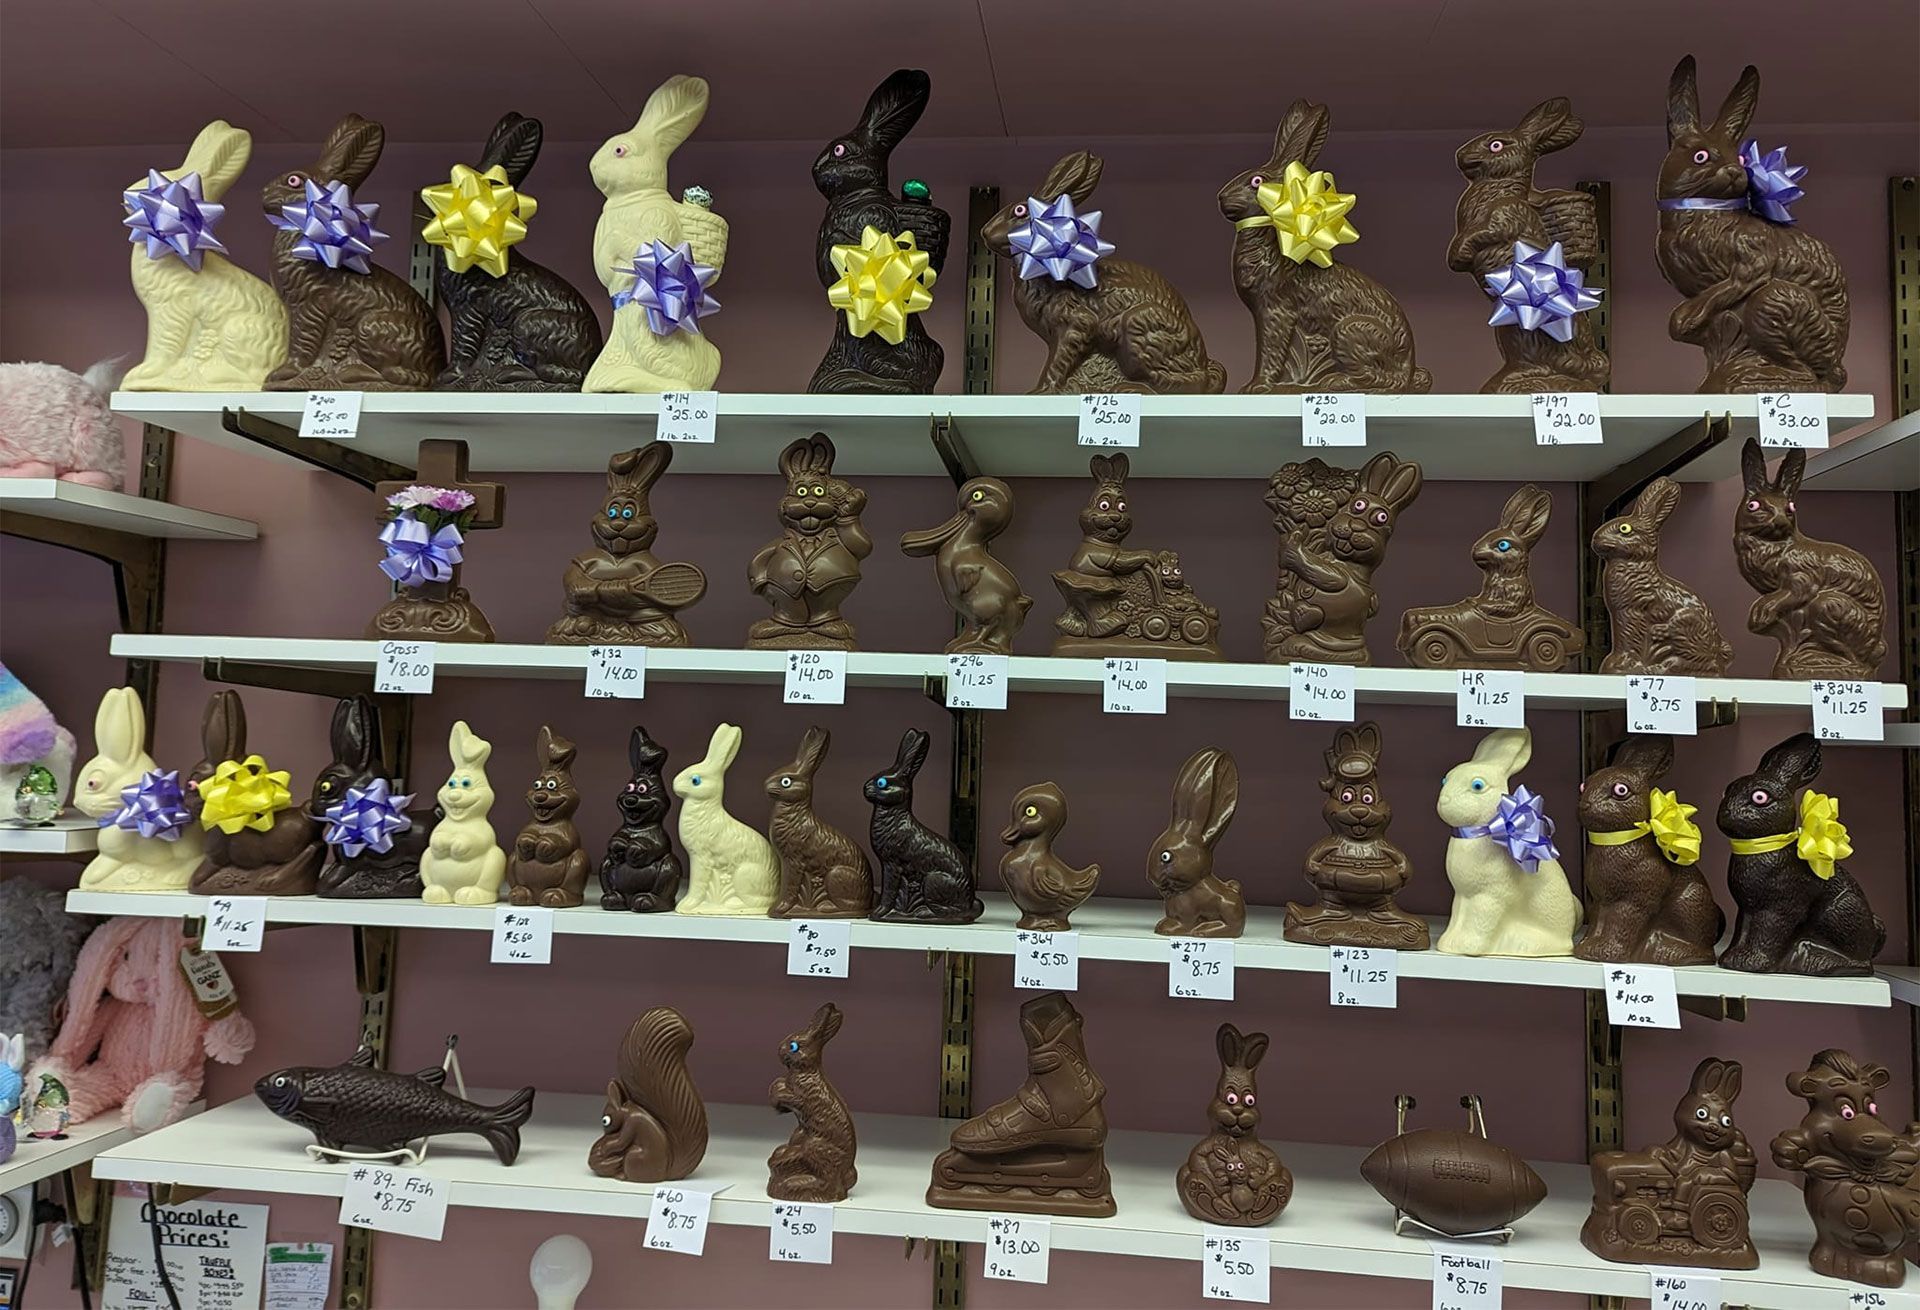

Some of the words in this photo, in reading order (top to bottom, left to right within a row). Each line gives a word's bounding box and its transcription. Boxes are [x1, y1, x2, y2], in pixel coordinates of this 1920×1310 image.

[663, 393, 690, 405] #114
[1083, 395, 1118, 406] #126
[1305, 395, 1339, 406] #230
[1532, 395, 1568, 407] #197
[666, 405, 709, 421] $25.00
[1091, 406, 1131, 424] $25.00
[1314, 407, 1356, 425] $22.00
[1546, 409, 1595, 428] $22.00
[1768, 408, 1820, 428] $33.00
[383, 641, 420, 655] Cross
[591, 648, 622, 659] #132
[388, 655, 430, 677] $18.00
[790, 653, 821, 664] #120
[950, 655, 984, 667] #296
[1106, 660, 1139, 671] #121
[600, 660, 638, 680] $14.00
[791, 662, 834, 682] $14.00
[955, 668, 996, 686] $11.25
[1293, 665, 1328, 678] #140
[1111, 674, 1148, 691] $14.00
[1629, 678, 1665, 691] #77
[1813, 681, 1864, 695] #8242
[1304, 683, 1346, 700] $14.00
[1469, 687, 1510, 705] $11.25
[1641, 691, 1681, 712] $8.75
[1822, 695, 1868, 715] $11.25
[798, 924, 819, 940] #80
[1017, 932, 1053, 945] #364
[805, 943, 837, 958] $7.50
[1171, 941, 1207, 953] #277
[1332, 948, 1369, 960] #123
[1031, 950, 1069, 966] $5.50
[1182, 953, 1221, 977] $8.75
[1342, 964, 1388, 984] $11.25
[1610, 969, 1636, 985] #81
[1615, 989, 1655, 1005] $14.00
[405, 1177, 434, 1197] Fish
[374, 1190, 417, 1214] $8.75
[656, 1190, 684, 1203] #60
[141, 1202, 240, 1228] Chocolate
[662, 1206, 698, 1229] $8.75
[775, 1205, 802, 1217] #24
[782, 1218, 817, 1236] $5.50
[995, 1235, 1040, 1254] $13.00
[1206, 1239, 1242, 1252] #135
[1214, 1253, 1255, 1275] $5.50
[1441, 1255, 1491, 1271] Football
[1446, 1272, 1488, 1294] $8.75
[1655, 1278, 1687, 1290] #160
[1663, 1293, 1707, 1310] $1400
[1849, 1292, 1886, 1306] #156
